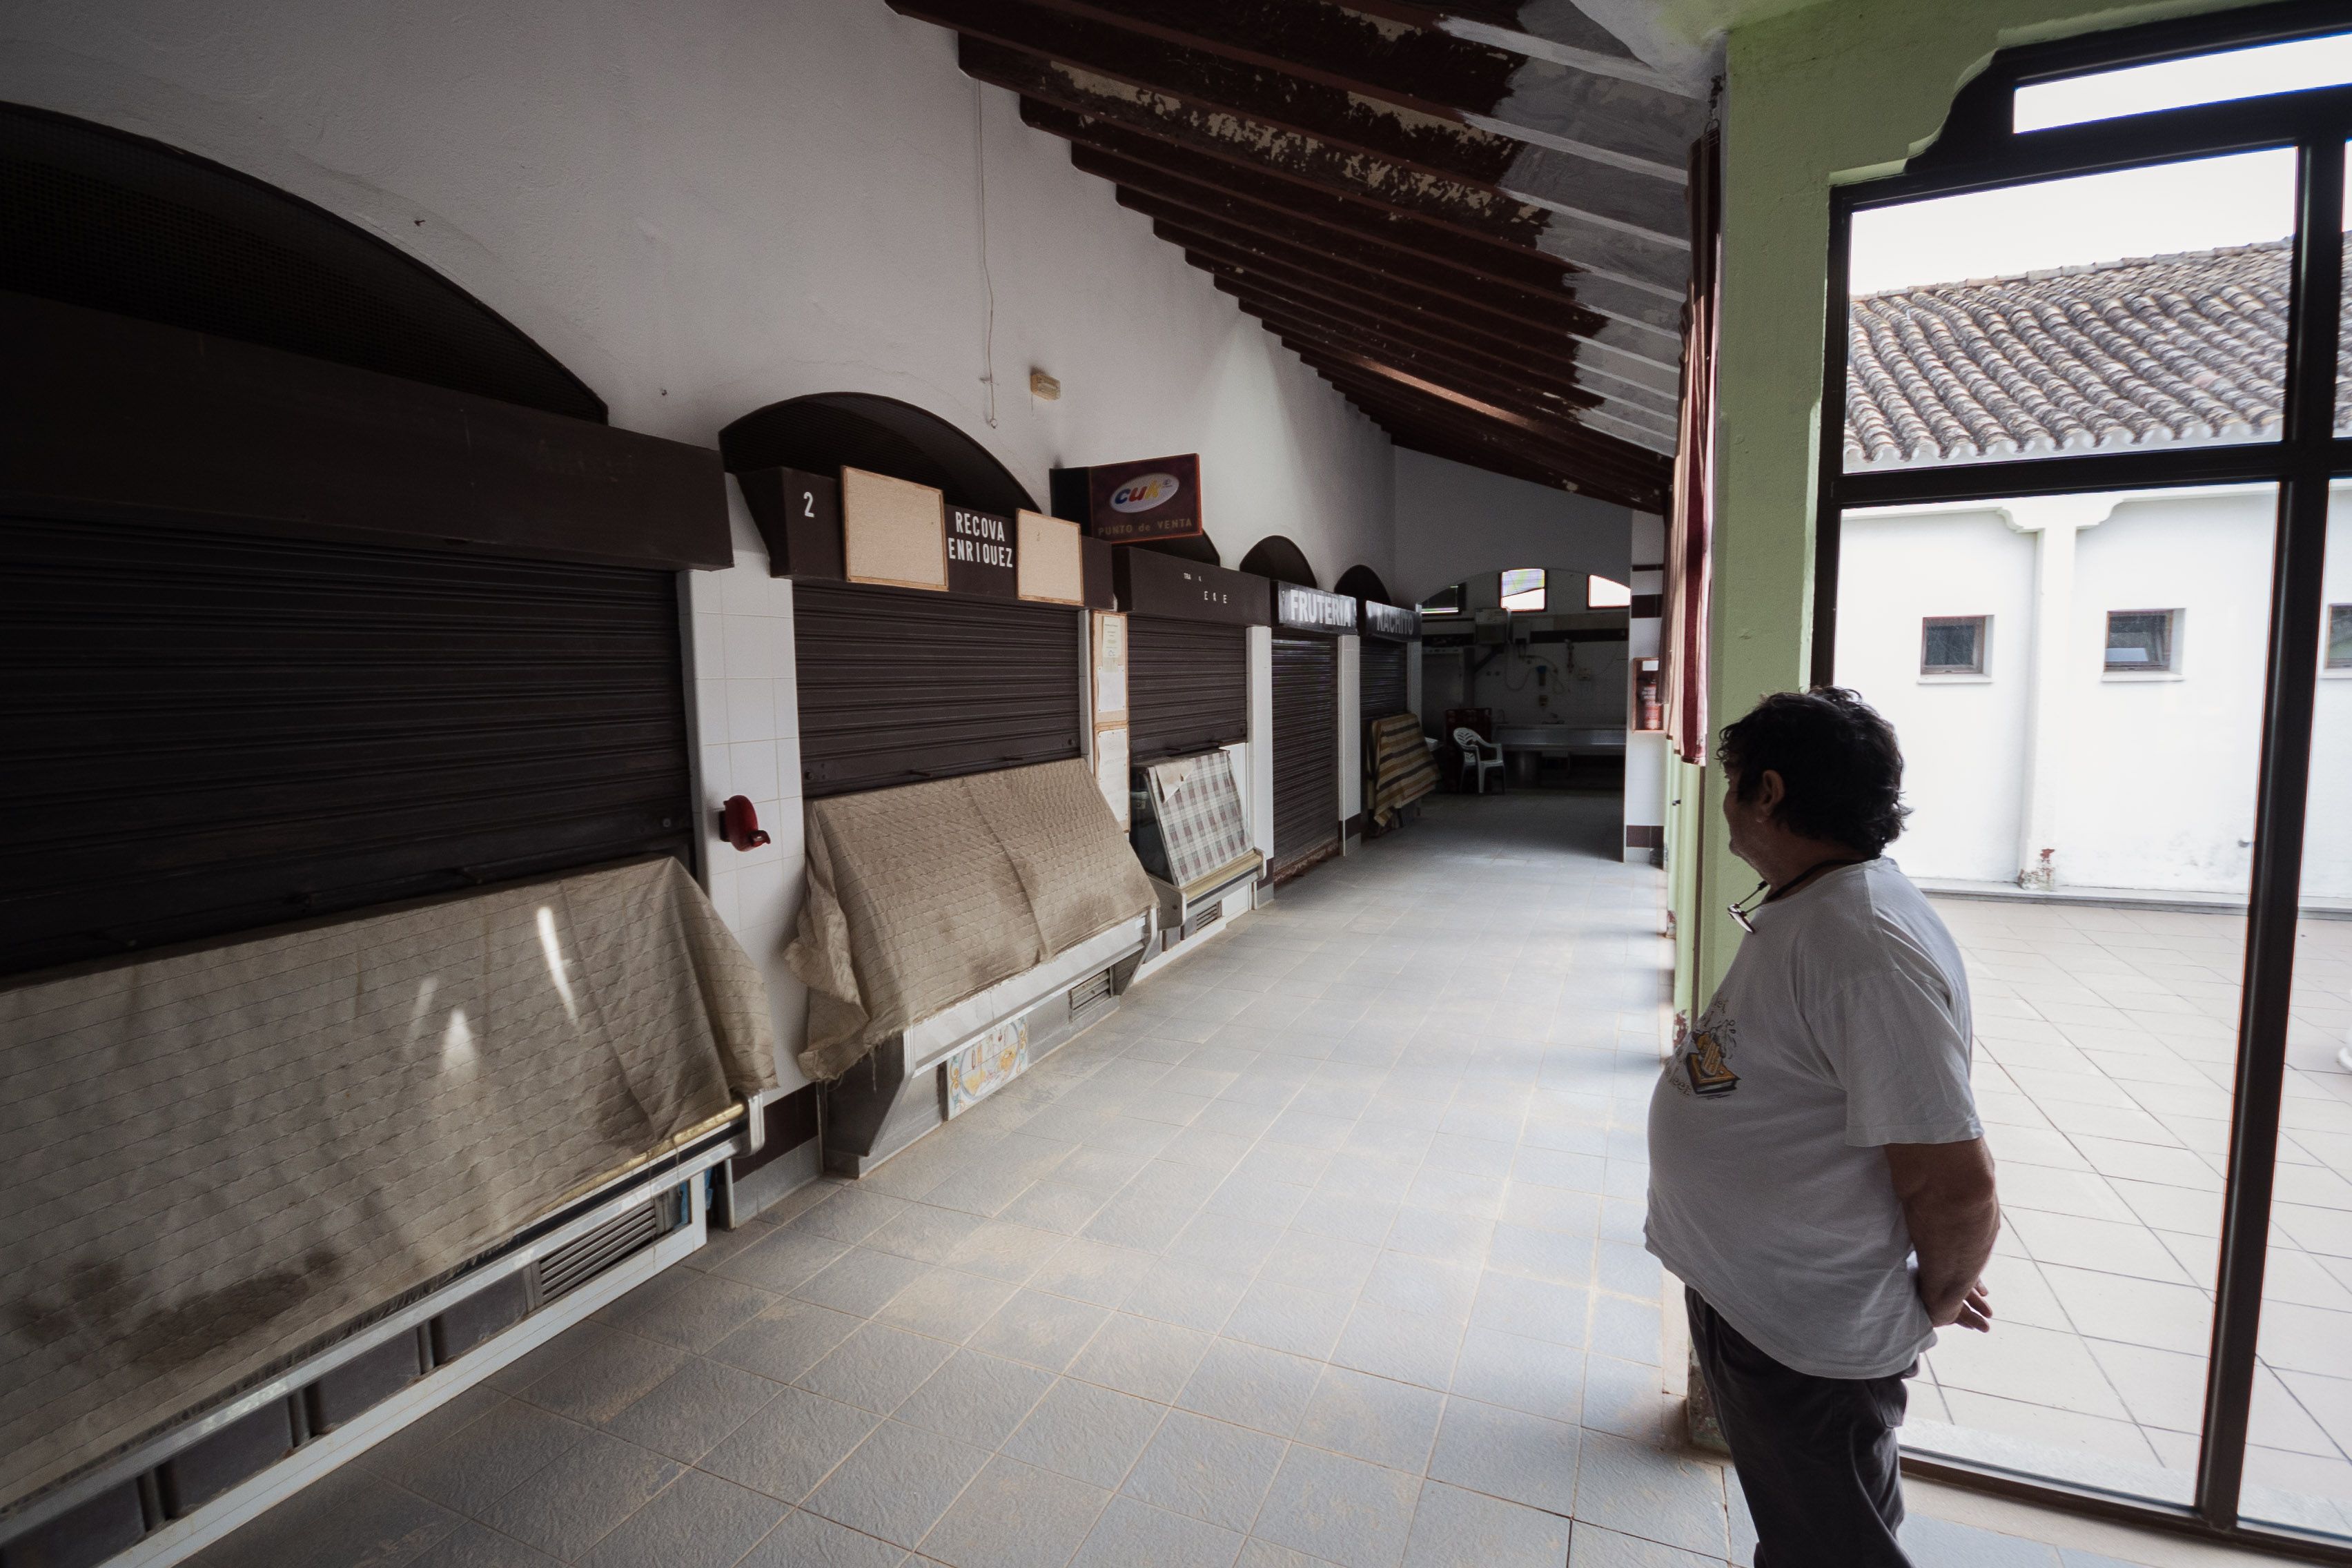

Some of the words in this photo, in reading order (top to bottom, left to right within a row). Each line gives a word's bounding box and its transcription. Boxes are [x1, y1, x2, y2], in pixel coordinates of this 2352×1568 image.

[803, 491, 814, 518] 2
[955, 511, 1005, 542] RECOVA
[1098, 525, 1133, 536] PUNTO
[1138, 523, 1150, 532] de
[1157, 518, 1193, 530] VENTA
[1290, 589, 1351, 627] FRUTERIA
